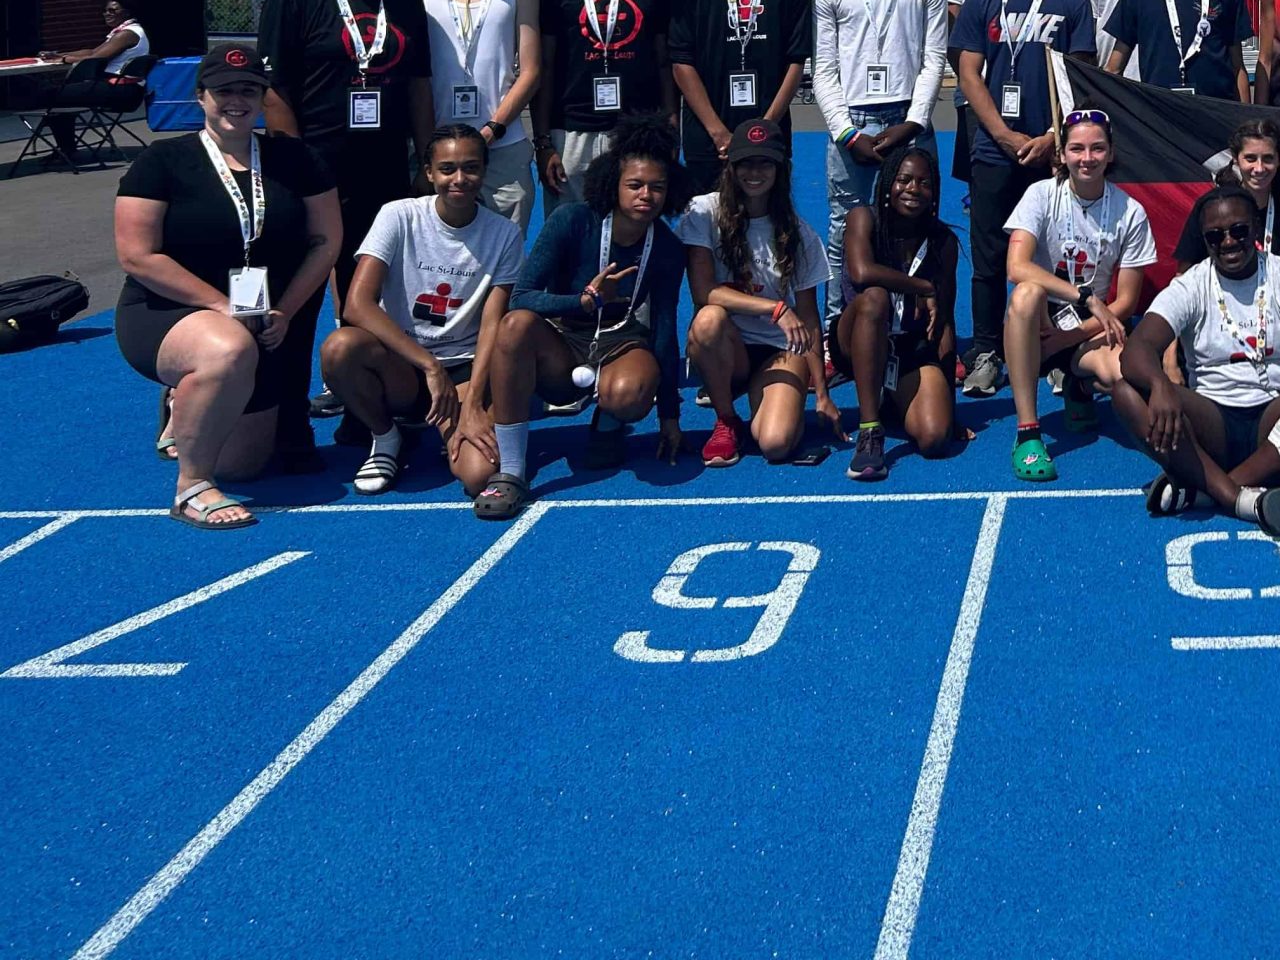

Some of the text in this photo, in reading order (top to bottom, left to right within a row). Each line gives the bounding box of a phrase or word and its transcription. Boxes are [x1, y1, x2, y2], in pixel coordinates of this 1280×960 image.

[998, 13, 1066, 43] NKE
[418, 261, 476, 278] Lac St-Louis
[612, 540, 822, 664] 6
